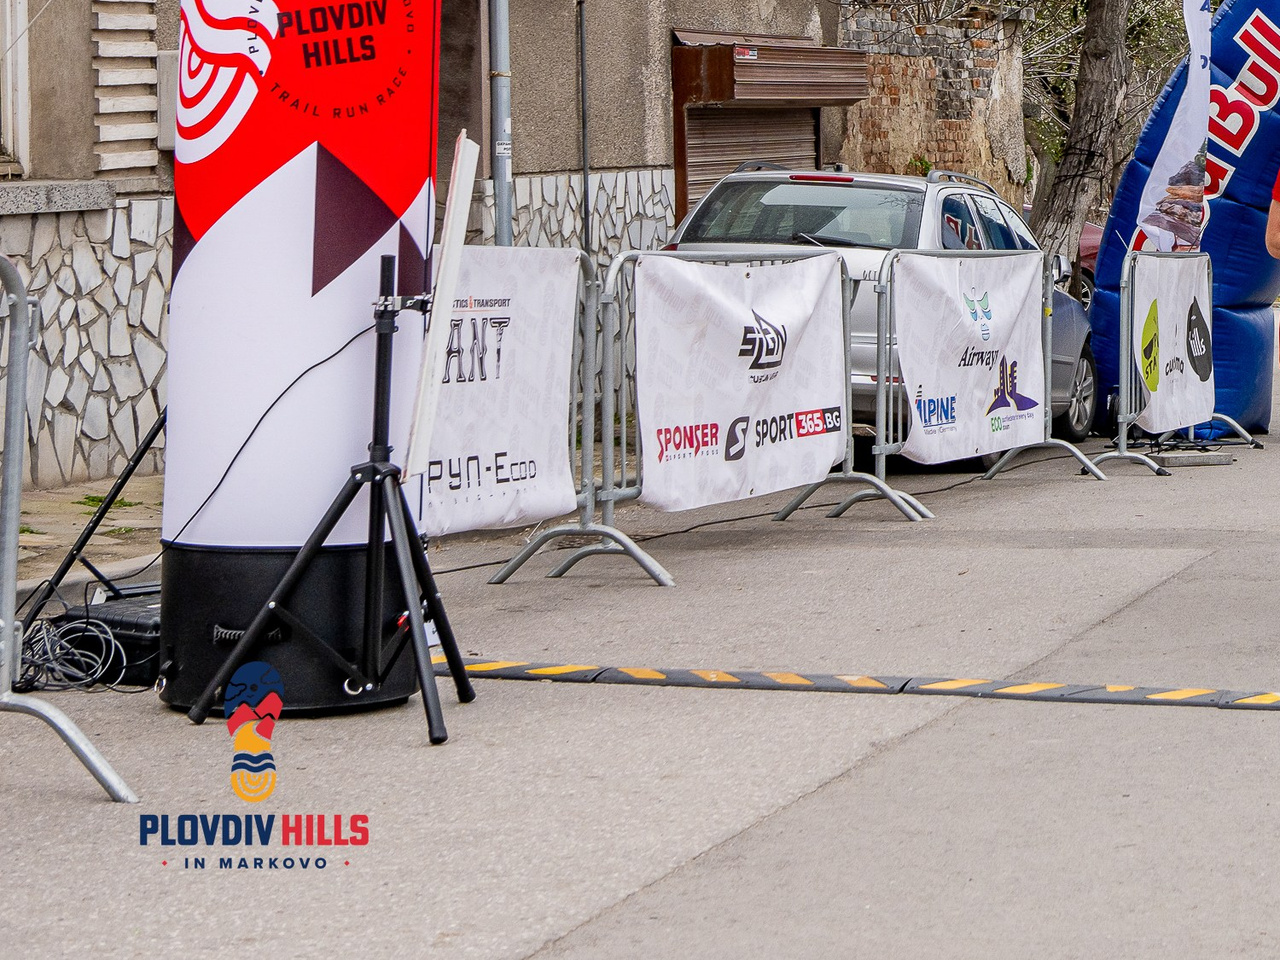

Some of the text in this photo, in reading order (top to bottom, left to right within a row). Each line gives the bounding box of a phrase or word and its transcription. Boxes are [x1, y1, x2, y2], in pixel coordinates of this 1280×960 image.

[301, 34, 377, 69] HILLS
[269, 66, 408, 119] TRAIL RUN RACE
[473, 298, 511, 308] TRANSPORT
[656, 423, 719, 464] SPONSER
